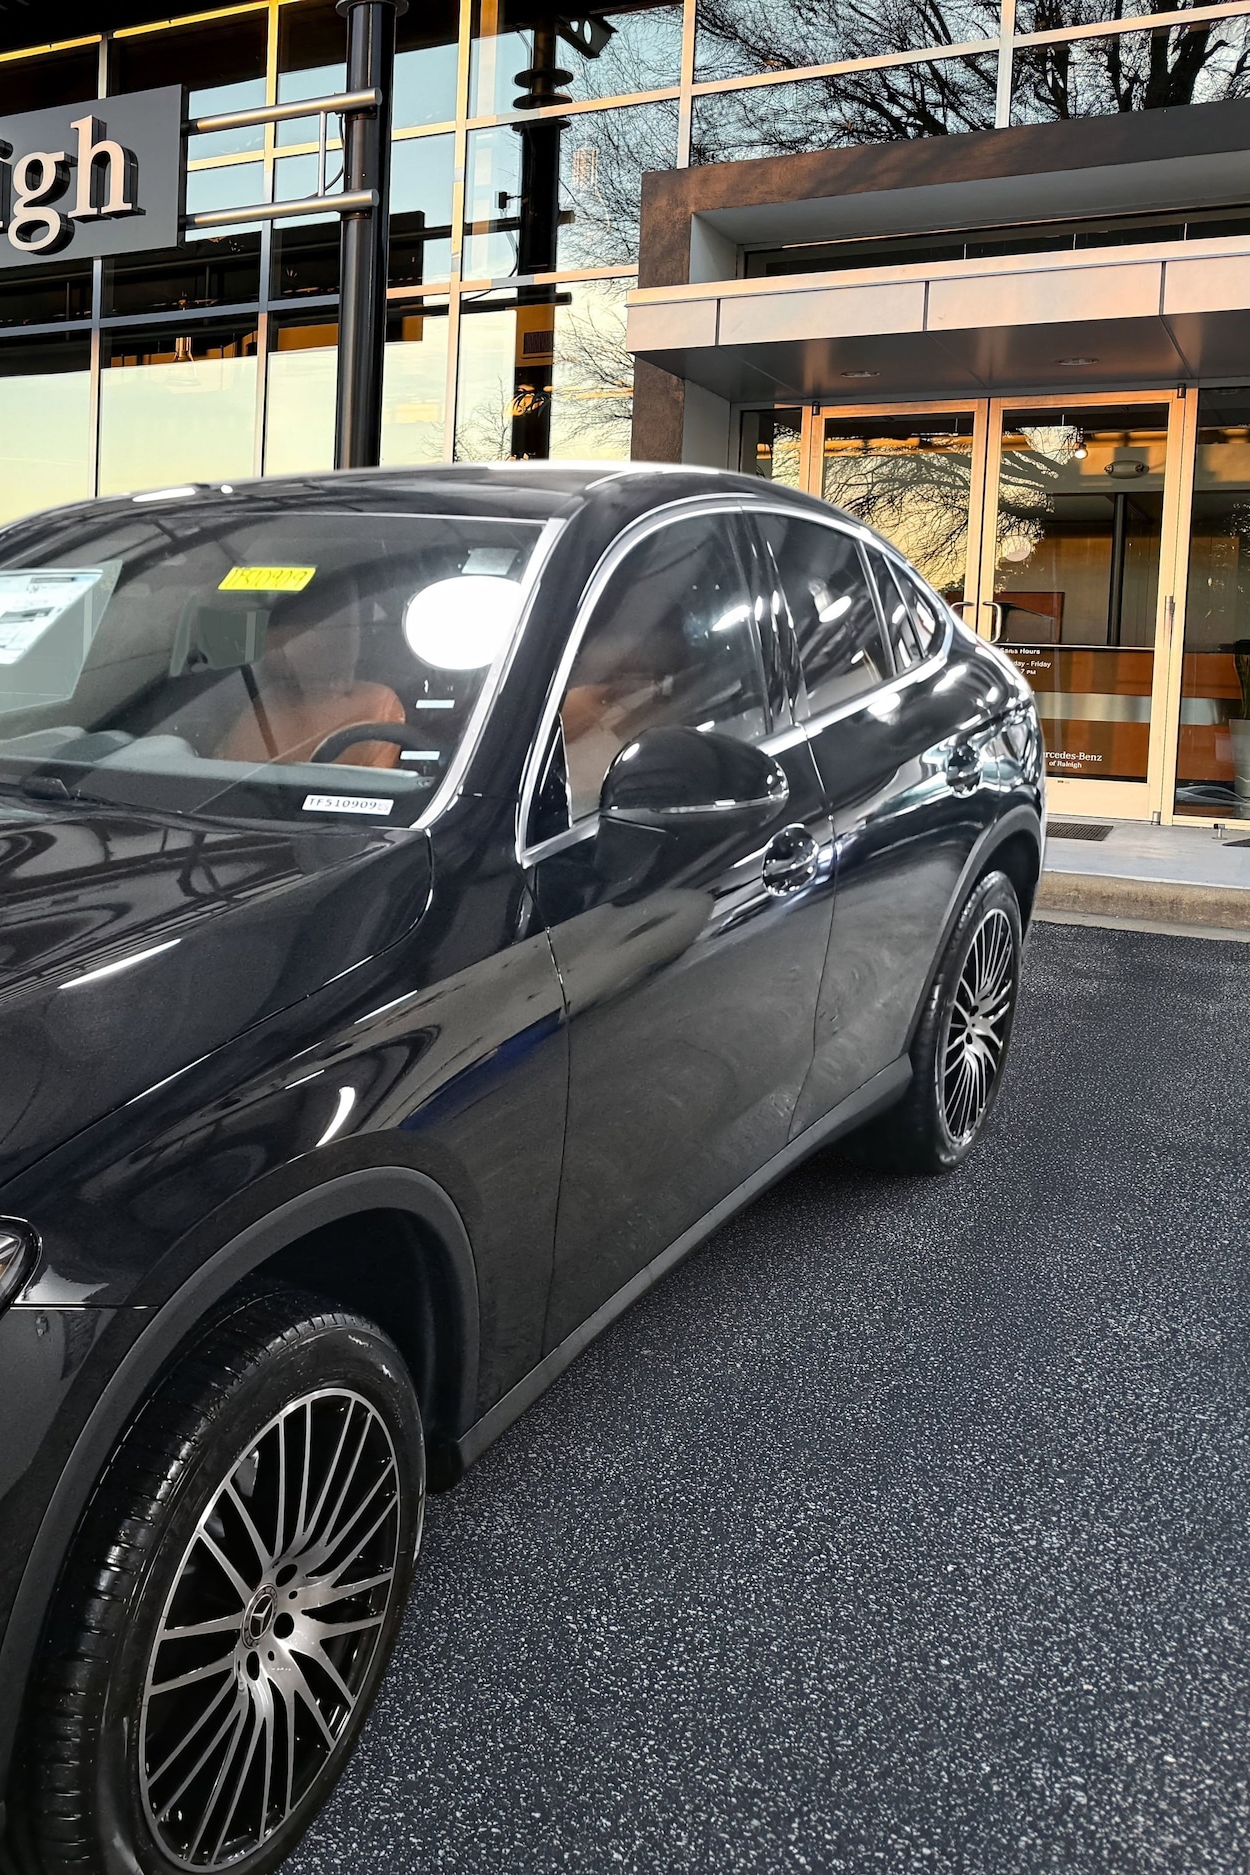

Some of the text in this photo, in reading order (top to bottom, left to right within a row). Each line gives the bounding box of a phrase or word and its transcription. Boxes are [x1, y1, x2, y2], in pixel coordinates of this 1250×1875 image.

[1030, 660, 1052, 669] Friday
[1043, 751, 1103, 762] rcedes-Benz
[1057, 760, 1083, 769] Raleigh
[309, 798, 377, 810] TF510909
